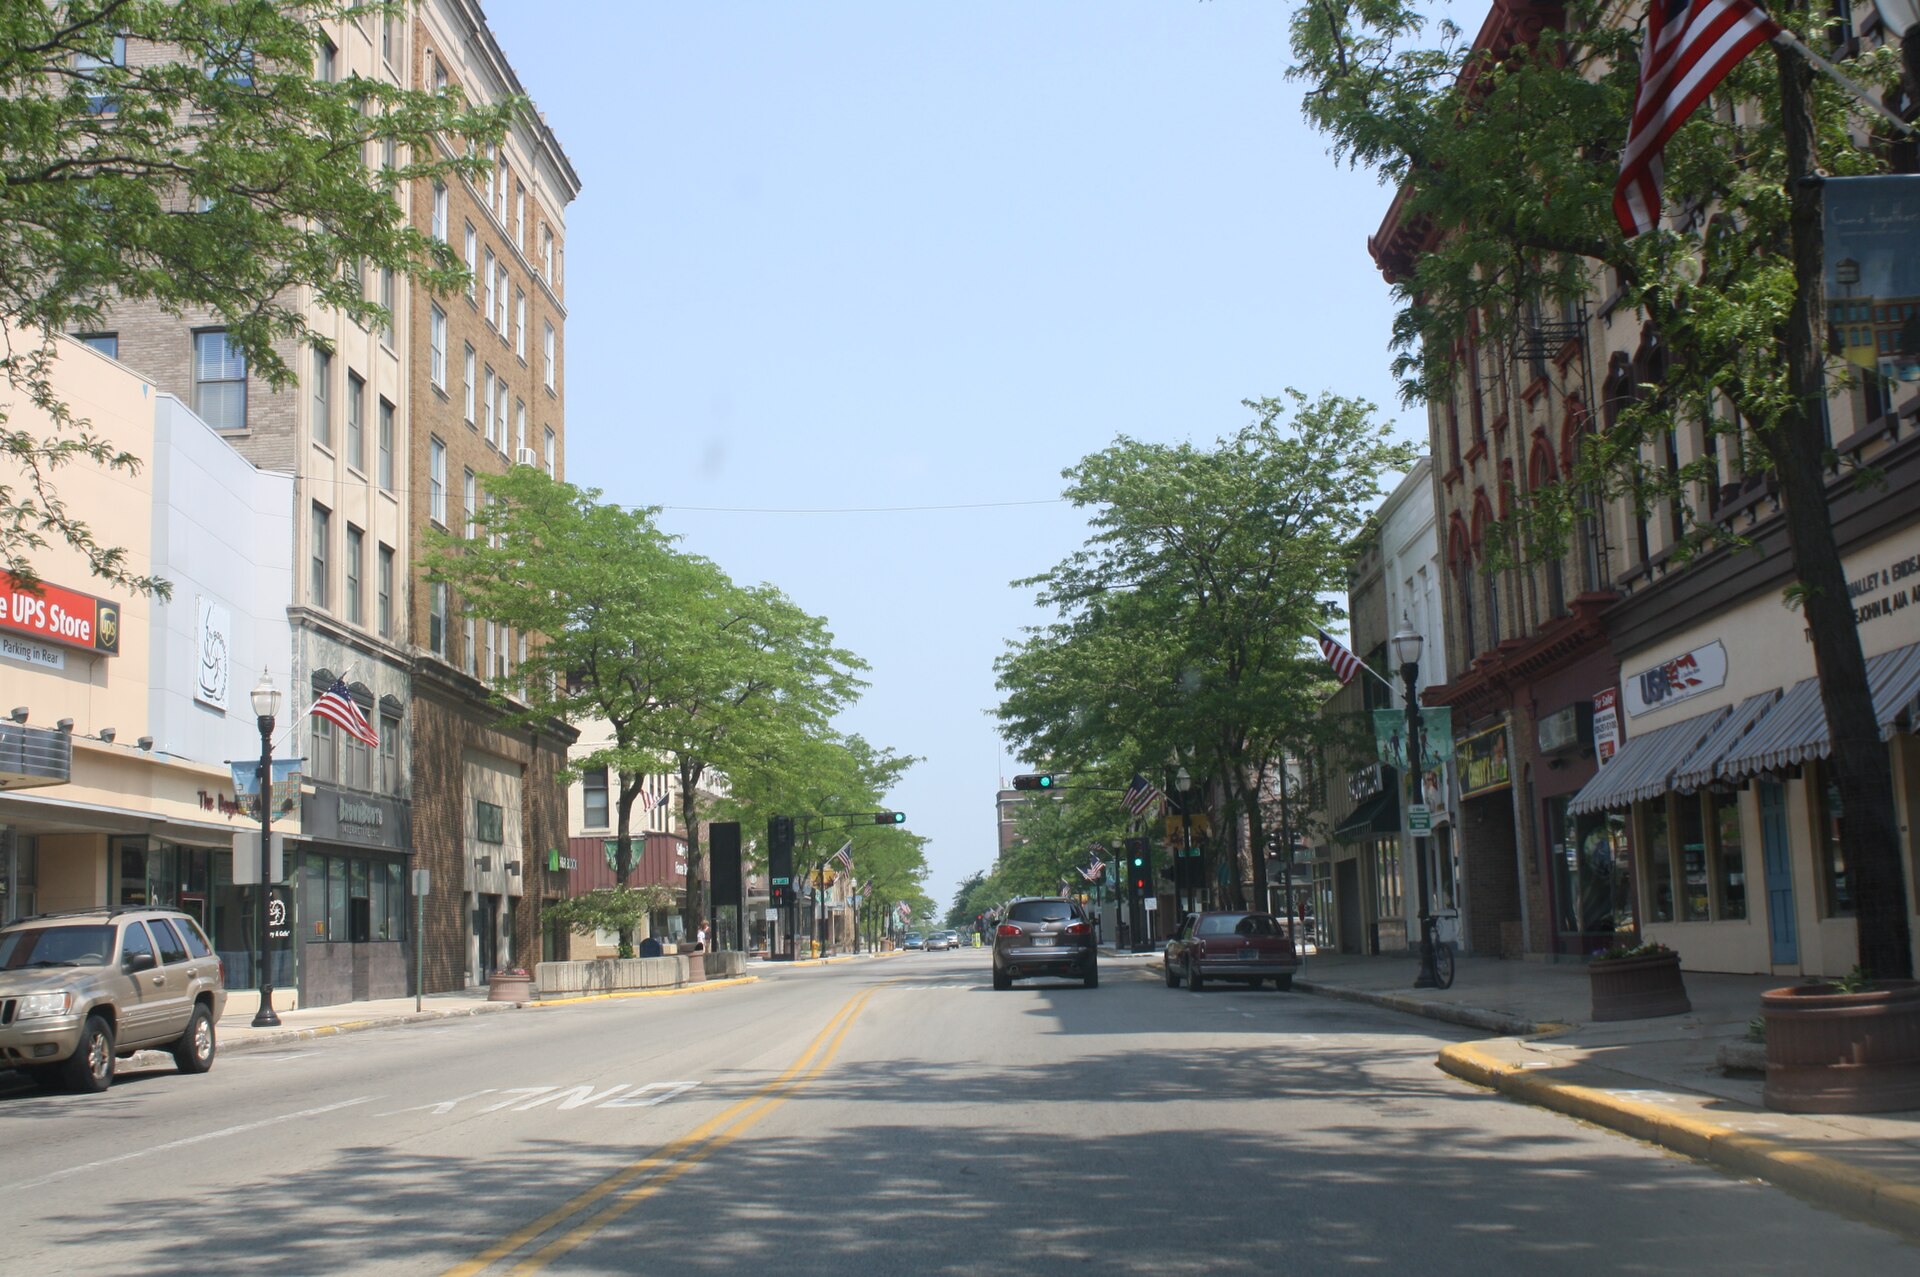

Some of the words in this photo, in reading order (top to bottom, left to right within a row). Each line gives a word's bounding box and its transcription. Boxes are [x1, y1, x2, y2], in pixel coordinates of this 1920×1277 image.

[13, 592, 46, 629] UPS
[50, 604, 91, 642] Store
[101, 619, 116, 641] ups
[3, 639, 32, 661] Parking
[33, 648, 41, 660] in
[42, 649, 59, 665] Rear
[1602, 694, 1614, 707] Sale
[197, 790, 215, 813] The
